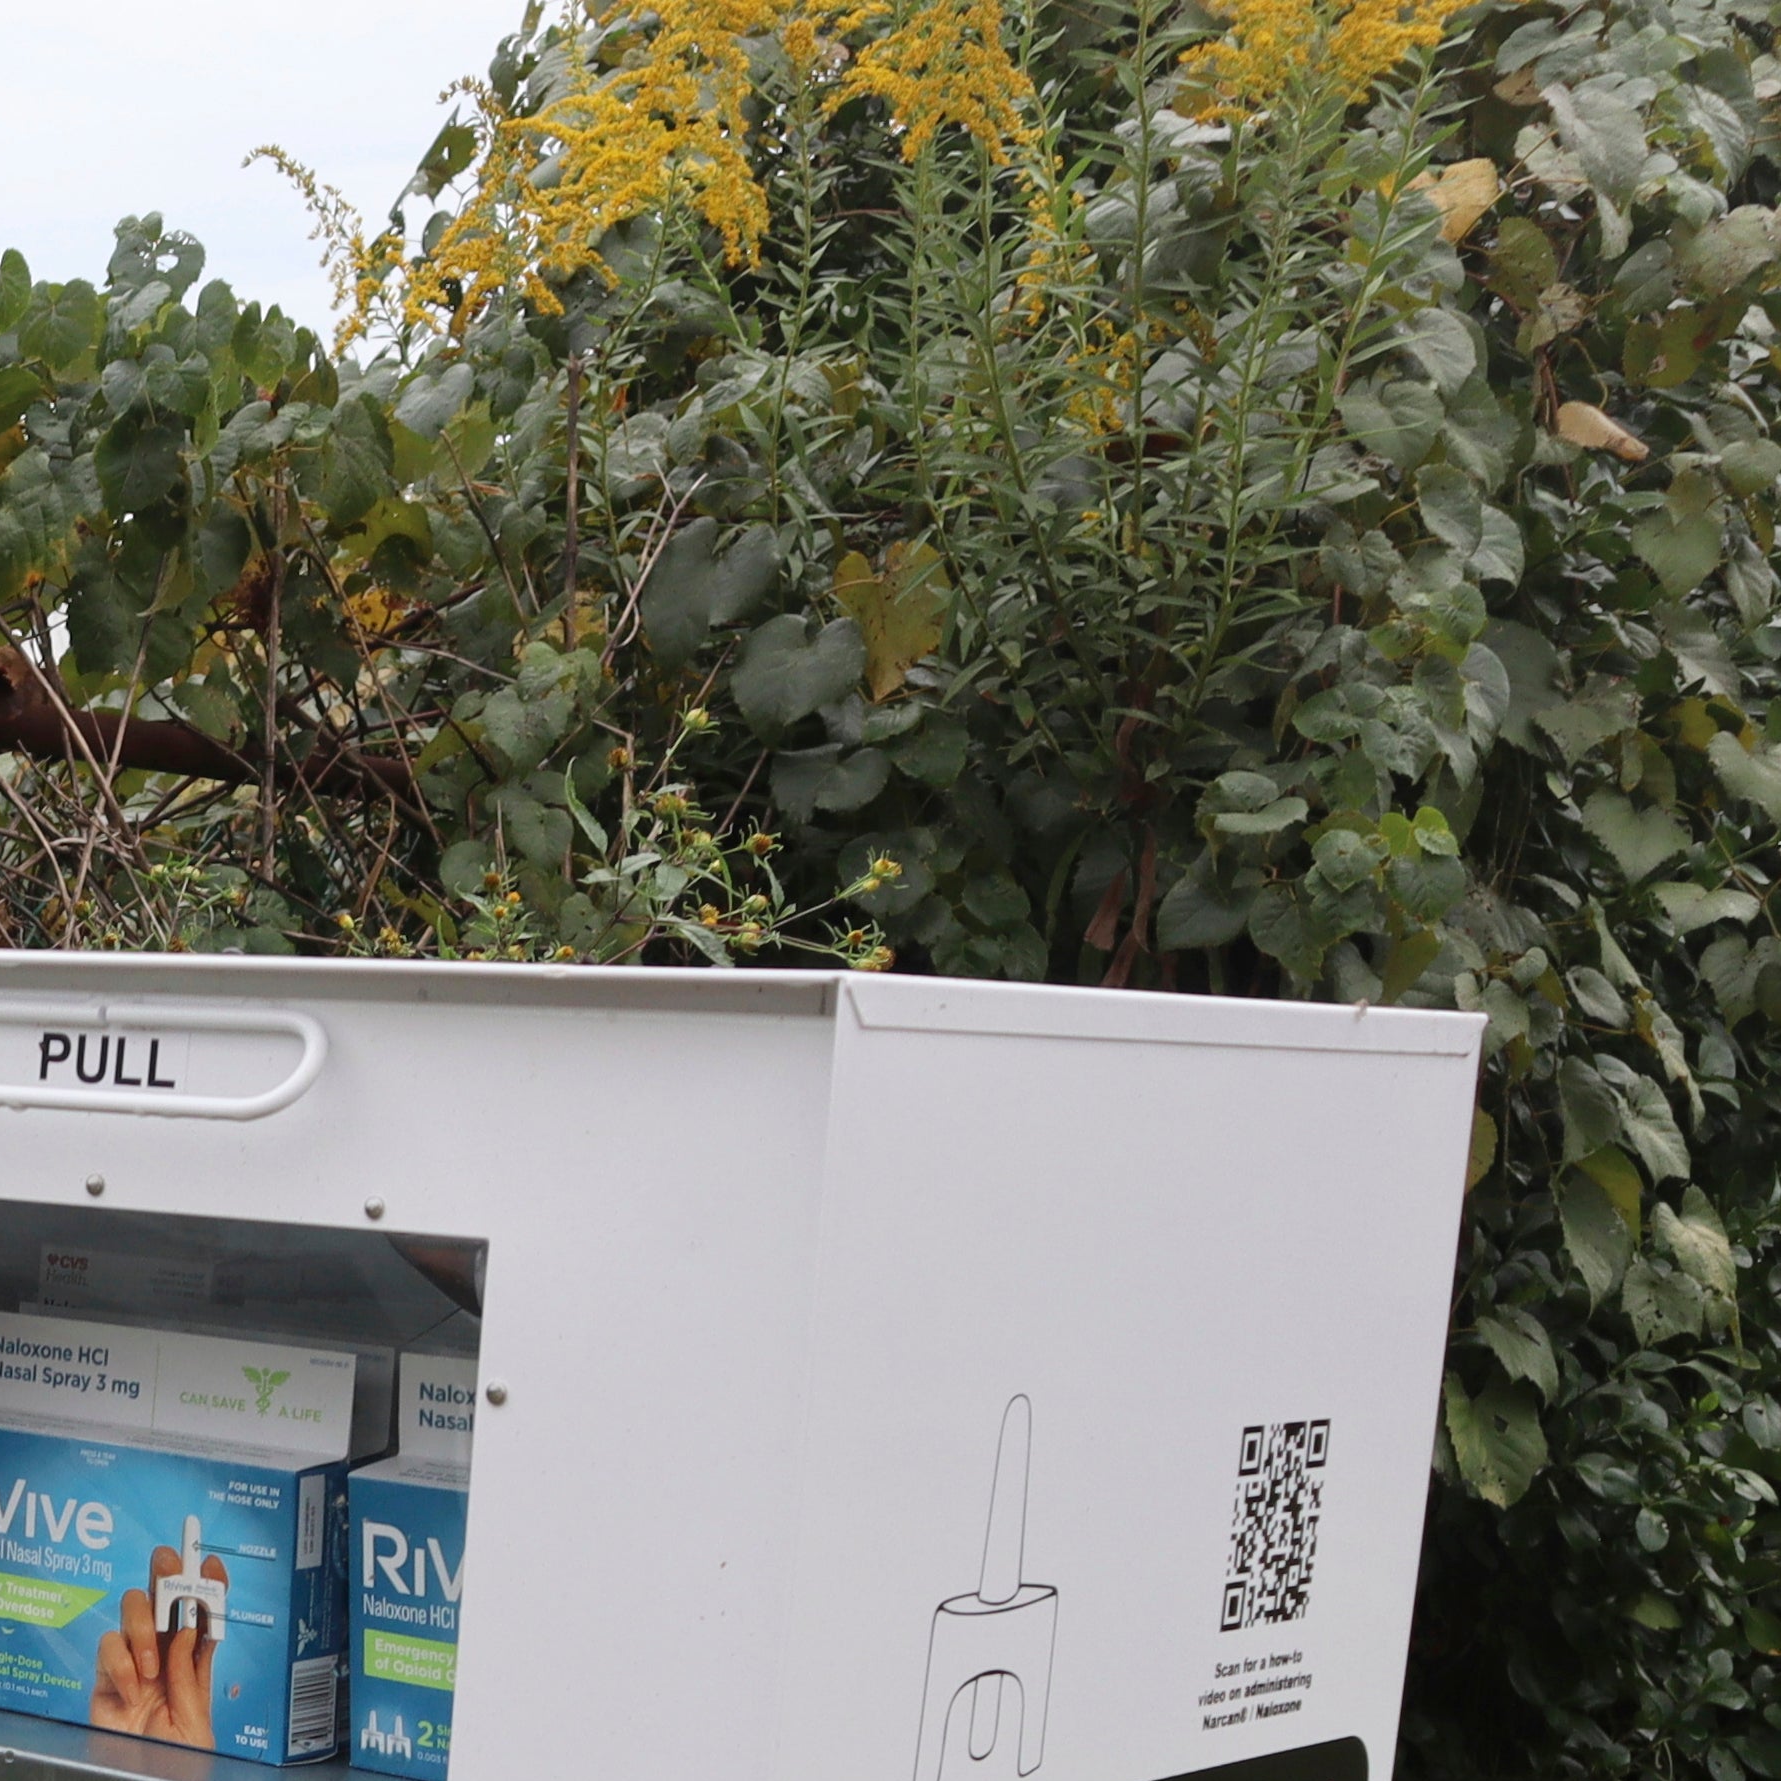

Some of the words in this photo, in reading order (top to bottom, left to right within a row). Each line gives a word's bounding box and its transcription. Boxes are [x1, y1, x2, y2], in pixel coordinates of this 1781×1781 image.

[38, 1031, 176, 1089] PULL
[42, 1367, 92, 1393] Spray
[96, 1374, 107, 1391] 3
[111, 1379, 141, 1399] mg
[419, 1382, 476, 1407] Nalox
[179, 1391, 208, 1405] CAN
[211, 1395, 246, 1412] SAVE
[278, 1406, 288, 1418] A
[292, 1407, 323, 1423] LIFE
[419, 1409, 474, 1432] Nasal
[208, 1490, 226, 1502] THE
[227, 1493, 252, 1506] NOSE
[254, 1497, 280, 1509] ONLY
[228, 1480, 248, 1492] FOR
[249, 1484, 268, 1495] USE
[269, 1487, 281, 1497] IN
[6, 1540, 42, 1565] Nasal
[44, 1549, 80, 1577] Spray
[81, 1554, 89, 1570] 3
[91, 1559, 113, 1582] mg
[362, 1519, 466, 1602] RiV
[230, 1608, 275, 1624] PLUNGER
[363, 1592, 427, 1625] Naloxone
[374, 1637, 455, 1667] Emergency
[1214, 1662, 1240, 1679] Scan
[1243, 1657, 1258, 1673] for
[1268, 1649, 1303, 1668] how-to
[12, 1667, 43, 1683] Spray
[43, 1672, 83, 1690] Devices
[375, 1657, 390, 1670] of
[393, 1659, 442, 1681] Opioid
[1198, 1687, 1226, 1707] video
[1229, 1687, 1241, 1701] on
[1244, 1673, 1313, 1698] administering
[1255, 1699, 1302, 1719] Naloxone
[235, 1734, 248, 1745] TO
[417, 1720, 434, 1748] 2
